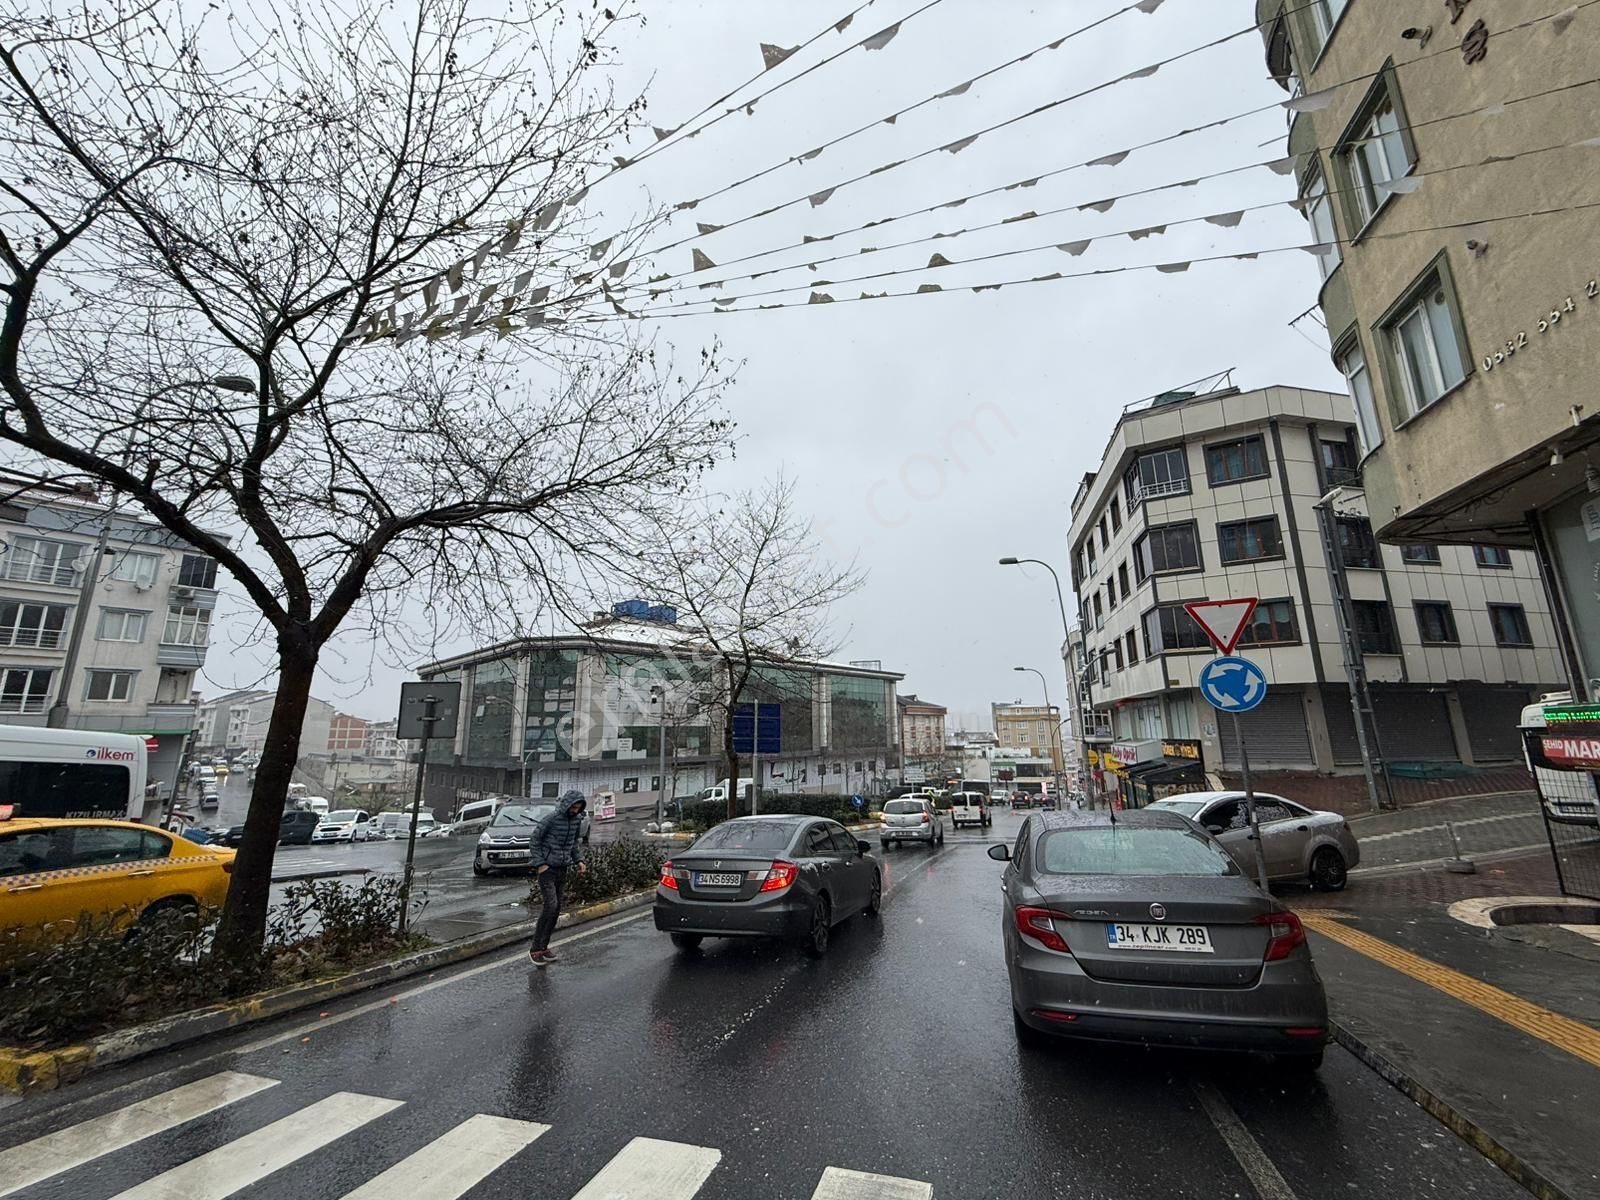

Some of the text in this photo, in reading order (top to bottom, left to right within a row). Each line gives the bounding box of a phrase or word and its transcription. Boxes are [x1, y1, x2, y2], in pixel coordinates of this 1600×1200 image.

[1482, 331, 1529, 371] 0532
[1536, 296, 1576, 333] 554
[97, 746, 134, 761] ilkem
[1116, 925, 1206, 945] 34 KJK 289
